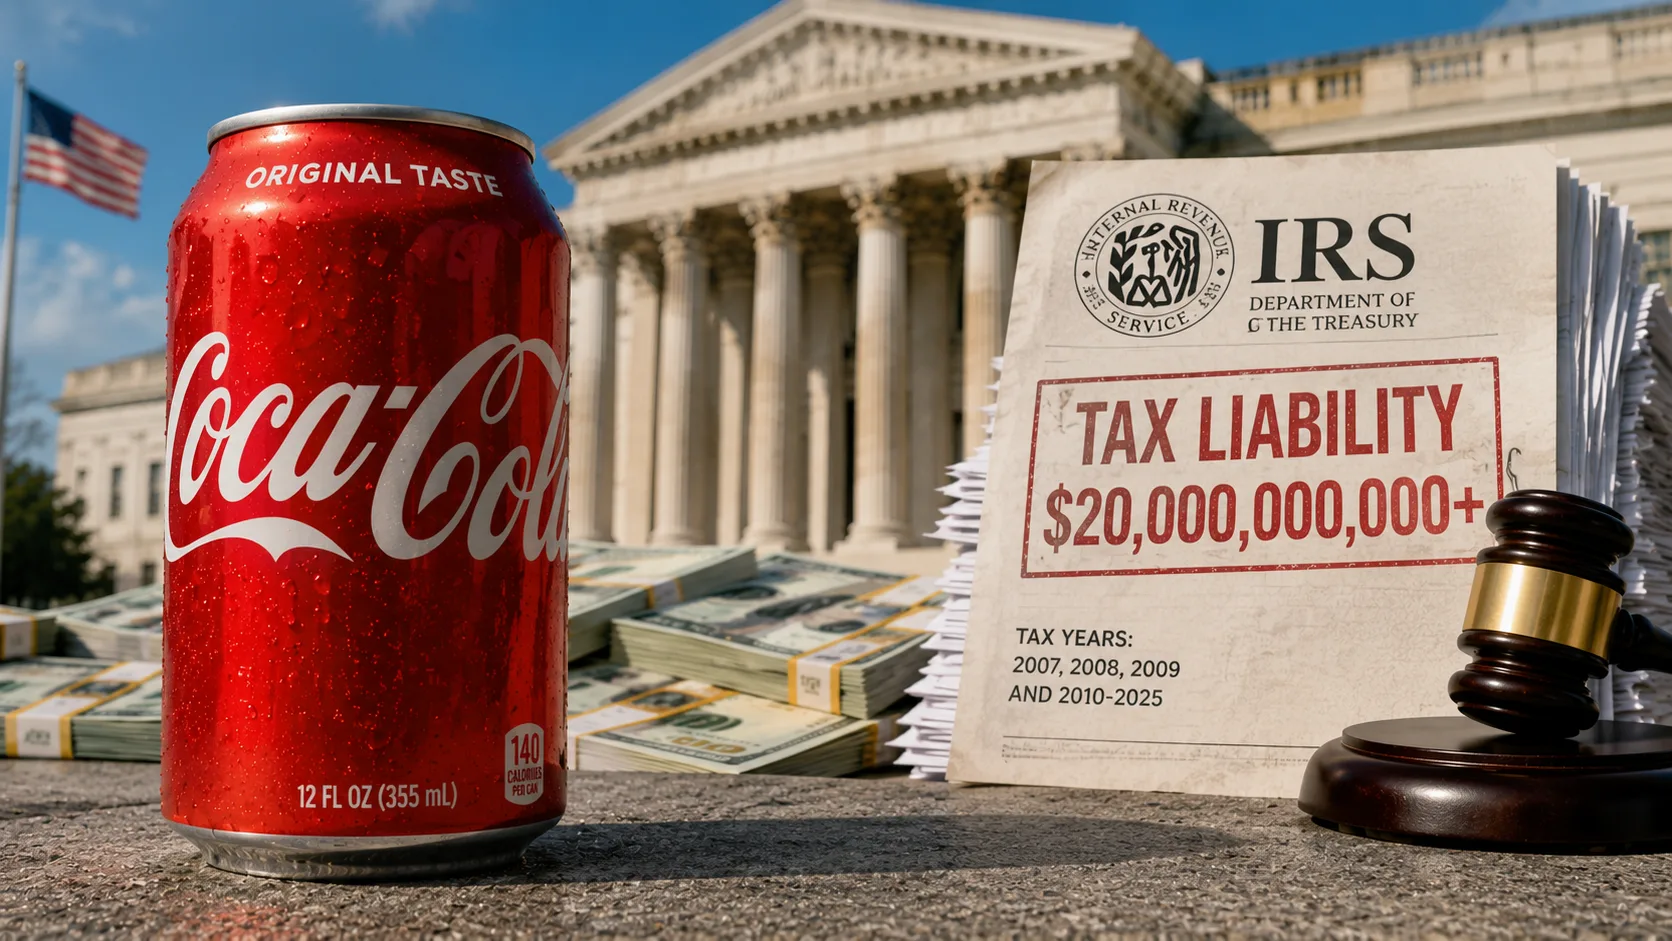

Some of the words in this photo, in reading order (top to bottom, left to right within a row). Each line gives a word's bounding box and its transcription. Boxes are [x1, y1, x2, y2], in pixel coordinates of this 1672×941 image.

[245, 162, 402, 188] ORIGINAL
[409, 164, 504, 197] TASTE
[1251, 213, 1415, 283] IRS
[1249, 293, 1385, 311] DEPARTMENT
[1390, 292, 1416, 307] OF
[1107, 311, 1190, 332] SERVICE
[1267, 316, 1307, 332] THE
[1311, 312, 1420, 330] TREASURY
[1076, 398, 1178, 466] TAX
[1199, 384, 1464, 461] LIABILITY
[1043, 475, 1485, 555] $20,000,000,000+
[1016, 628, 1055, 645] TAX
[1062, 629, 1133, 648] YEARS:
[1012, 656, 1063, 678] 2007,
[1070, 658, 1124, 680] 2008,
[1130, 660, 1180, 678] 2009
[1008, 685, 1053, 703] AND
[1058, 686, 1163, 707] 2010-2025
[511, 732, 540, 766] 140
[297, 784, 317, 809] 12
[322, 785, 343, 809] FL
[348, 784, 373, 809] OZ
[378, 783, 420, 812] (355
[425, 781, 458, 810] mL)
